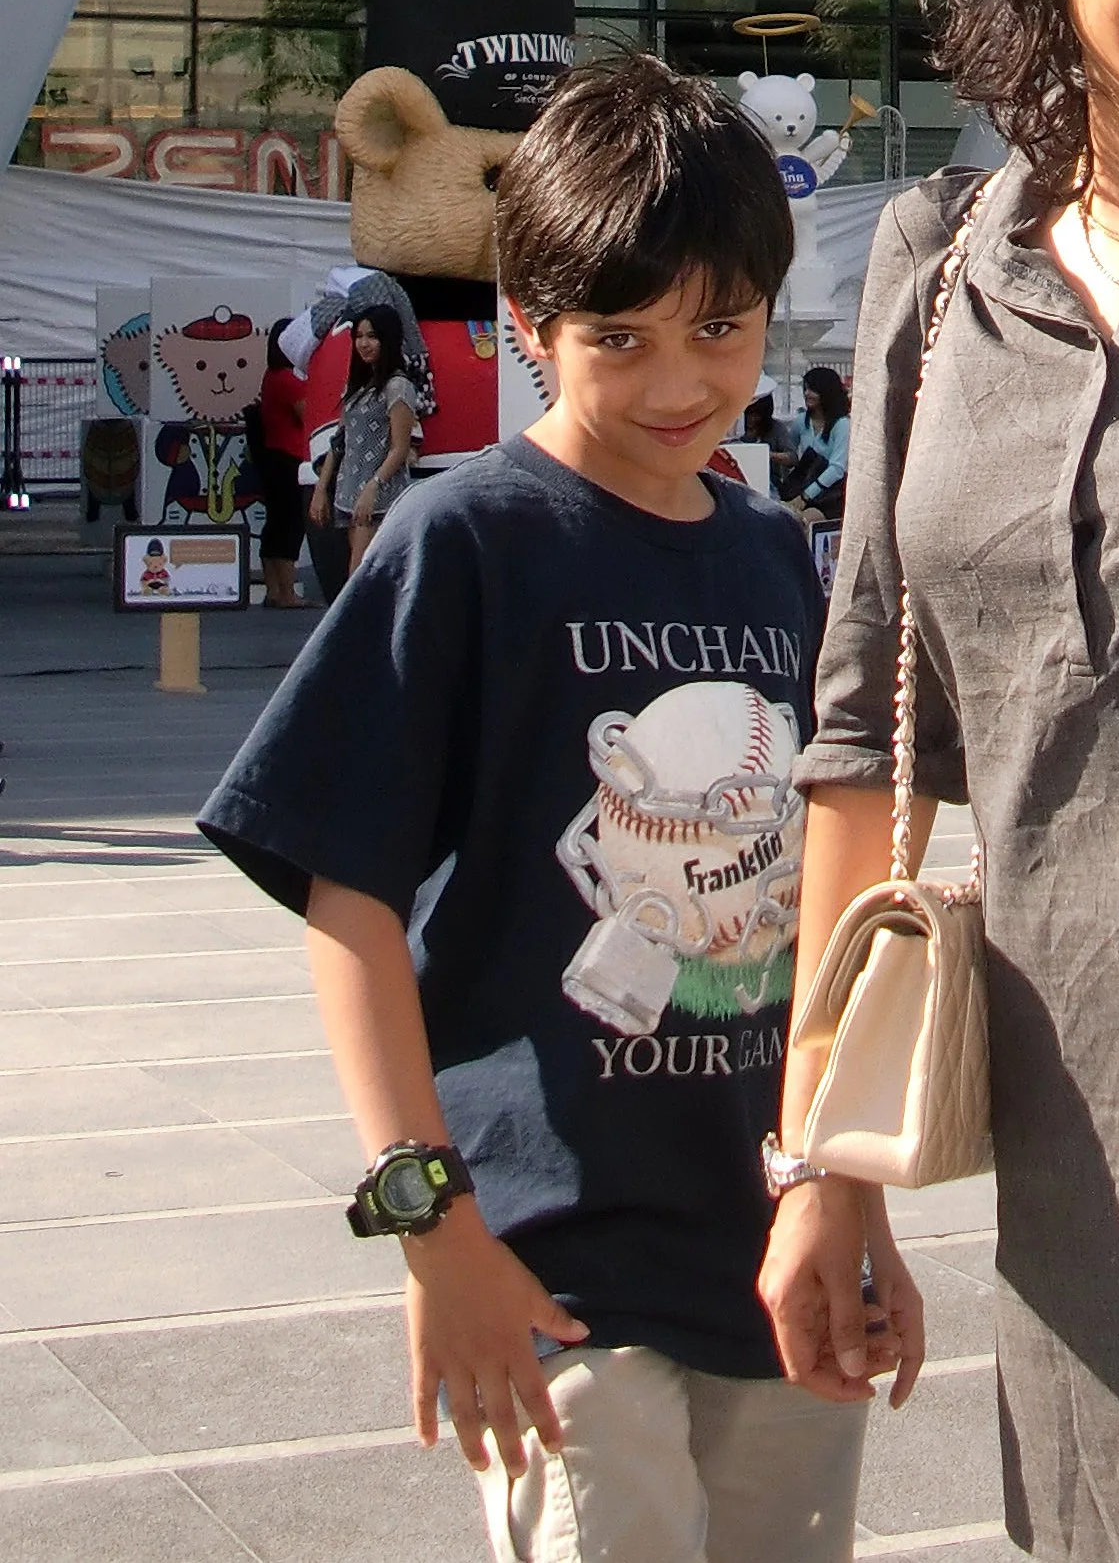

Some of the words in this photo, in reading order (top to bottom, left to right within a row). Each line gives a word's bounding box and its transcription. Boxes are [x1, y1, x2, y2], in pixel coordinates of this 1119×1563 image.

[565, 621, 800, 681] UNCHAIN
[683, 831, 784, 895] Franklin
[591, 1035, 732, 1080] YOUR
